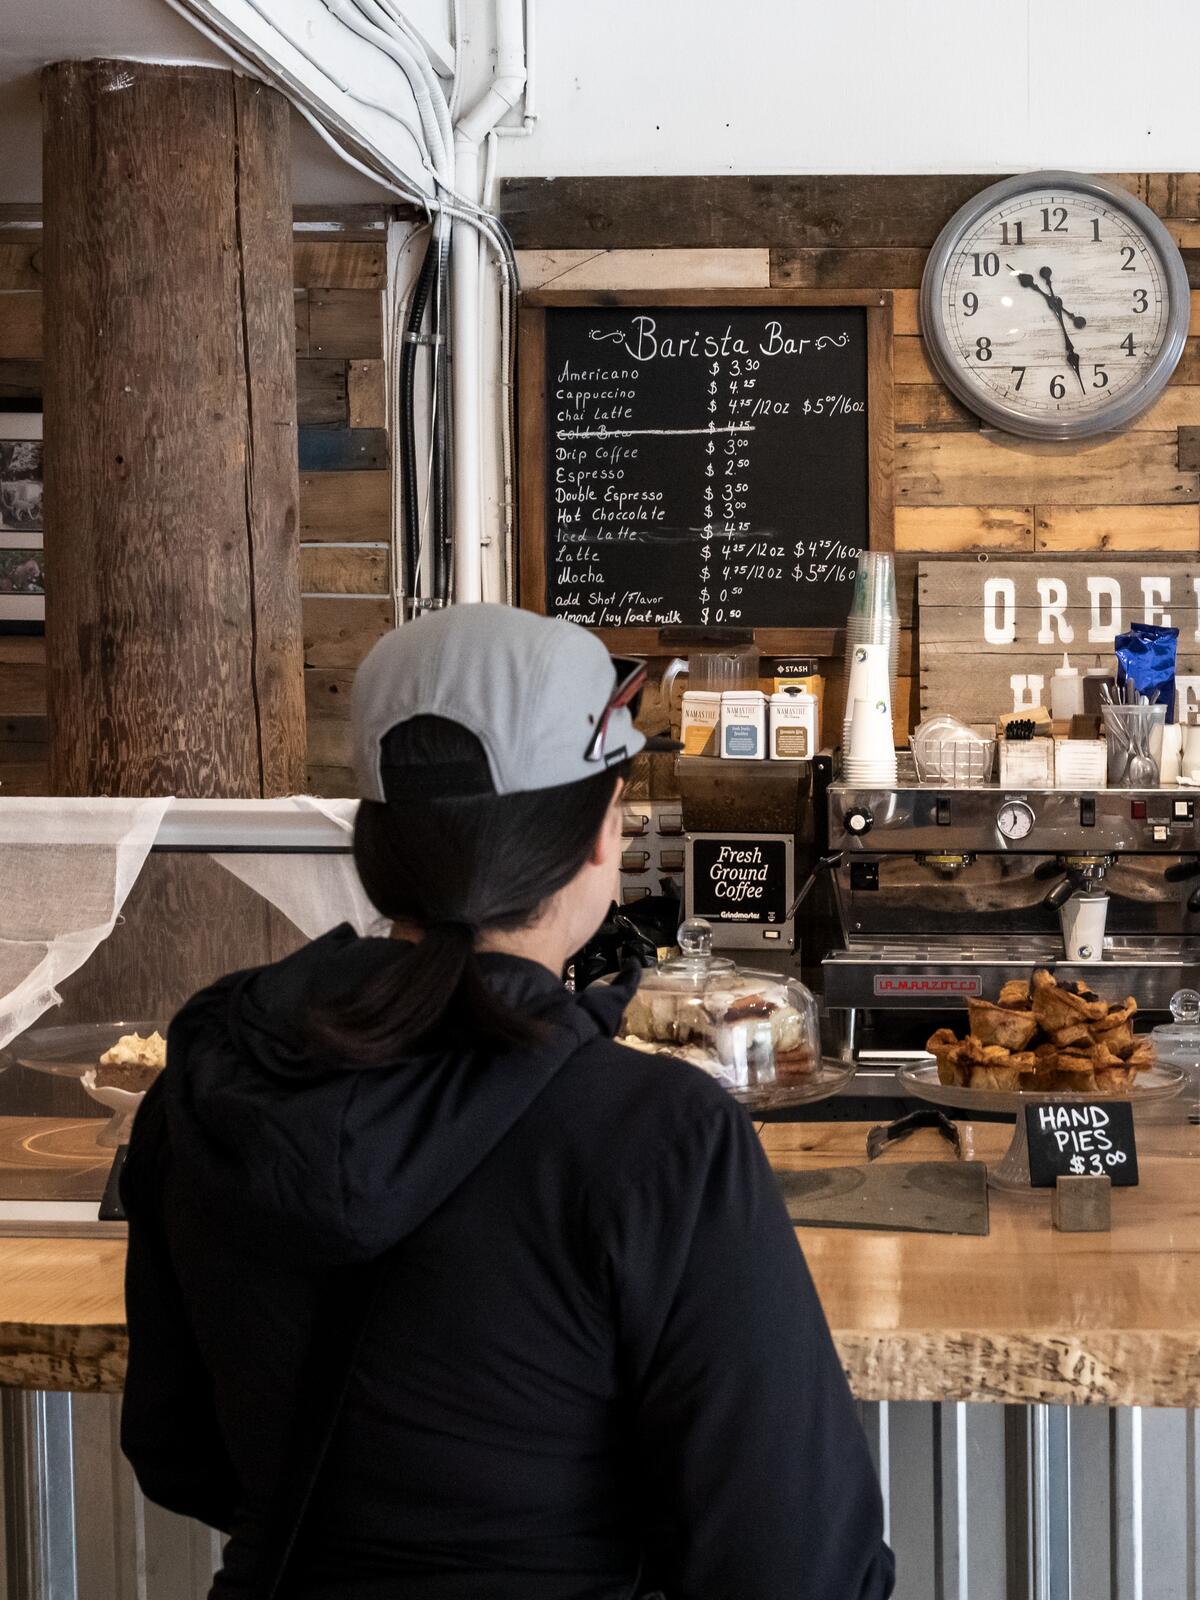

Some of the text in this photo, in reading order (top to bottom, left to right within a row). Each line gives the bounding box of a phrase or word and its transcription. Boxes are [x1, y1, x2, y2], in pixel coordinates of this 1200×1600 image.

[1040, 207, 1069, 232] 12
[1090, 218, 1102, 242] 1
[1000, 221, 1025, 245] 11
[971, 252, 1000, 277] 10
[1121, 246, 1136, 272] 2
[963, 292, 979, 316] 9
[1132, 289, 1149, 313] 3
[625, 316, 811, 360] Barista Bar
[975, 337, 992, 361] 8
[1120, 332, 1137, 356] 4
[558, 360, 639, 382] Americano
[1010, 366, 1026, 391] 7
[1093, 364, 1108, 388] 5
[1050, 375, 1065, 399] 6
[556, 447, 586, 464] Drip
[595, 446, 638, 464] Coffee
[556, 467, 625, 486] Espresso
[555, 485, 597, 503] Double
[604, 486, 663, 510] Espresso
[558, 507, 581, 523] Hot
[556, 528, 587, 542] Iced
[597, 526, 637, 541] Latte
[555, 545, 600, 563] Latte
[558, 565, 605, 584] Mocha
[555, 592, 580, 606] add
[655, 611, 682, 624] milk
[785, 665, 808, 673] STASH
[717, 846, 762, 863] Fresh
[710, 863, 769, 880] Ground
[715, 881, 763, 901] Coffee
[720, 911, 760, 919] Grindmaster
[1039, 1106, 1109, 1130] HAND
[1054, 1129, 1113, 1152] PIES
